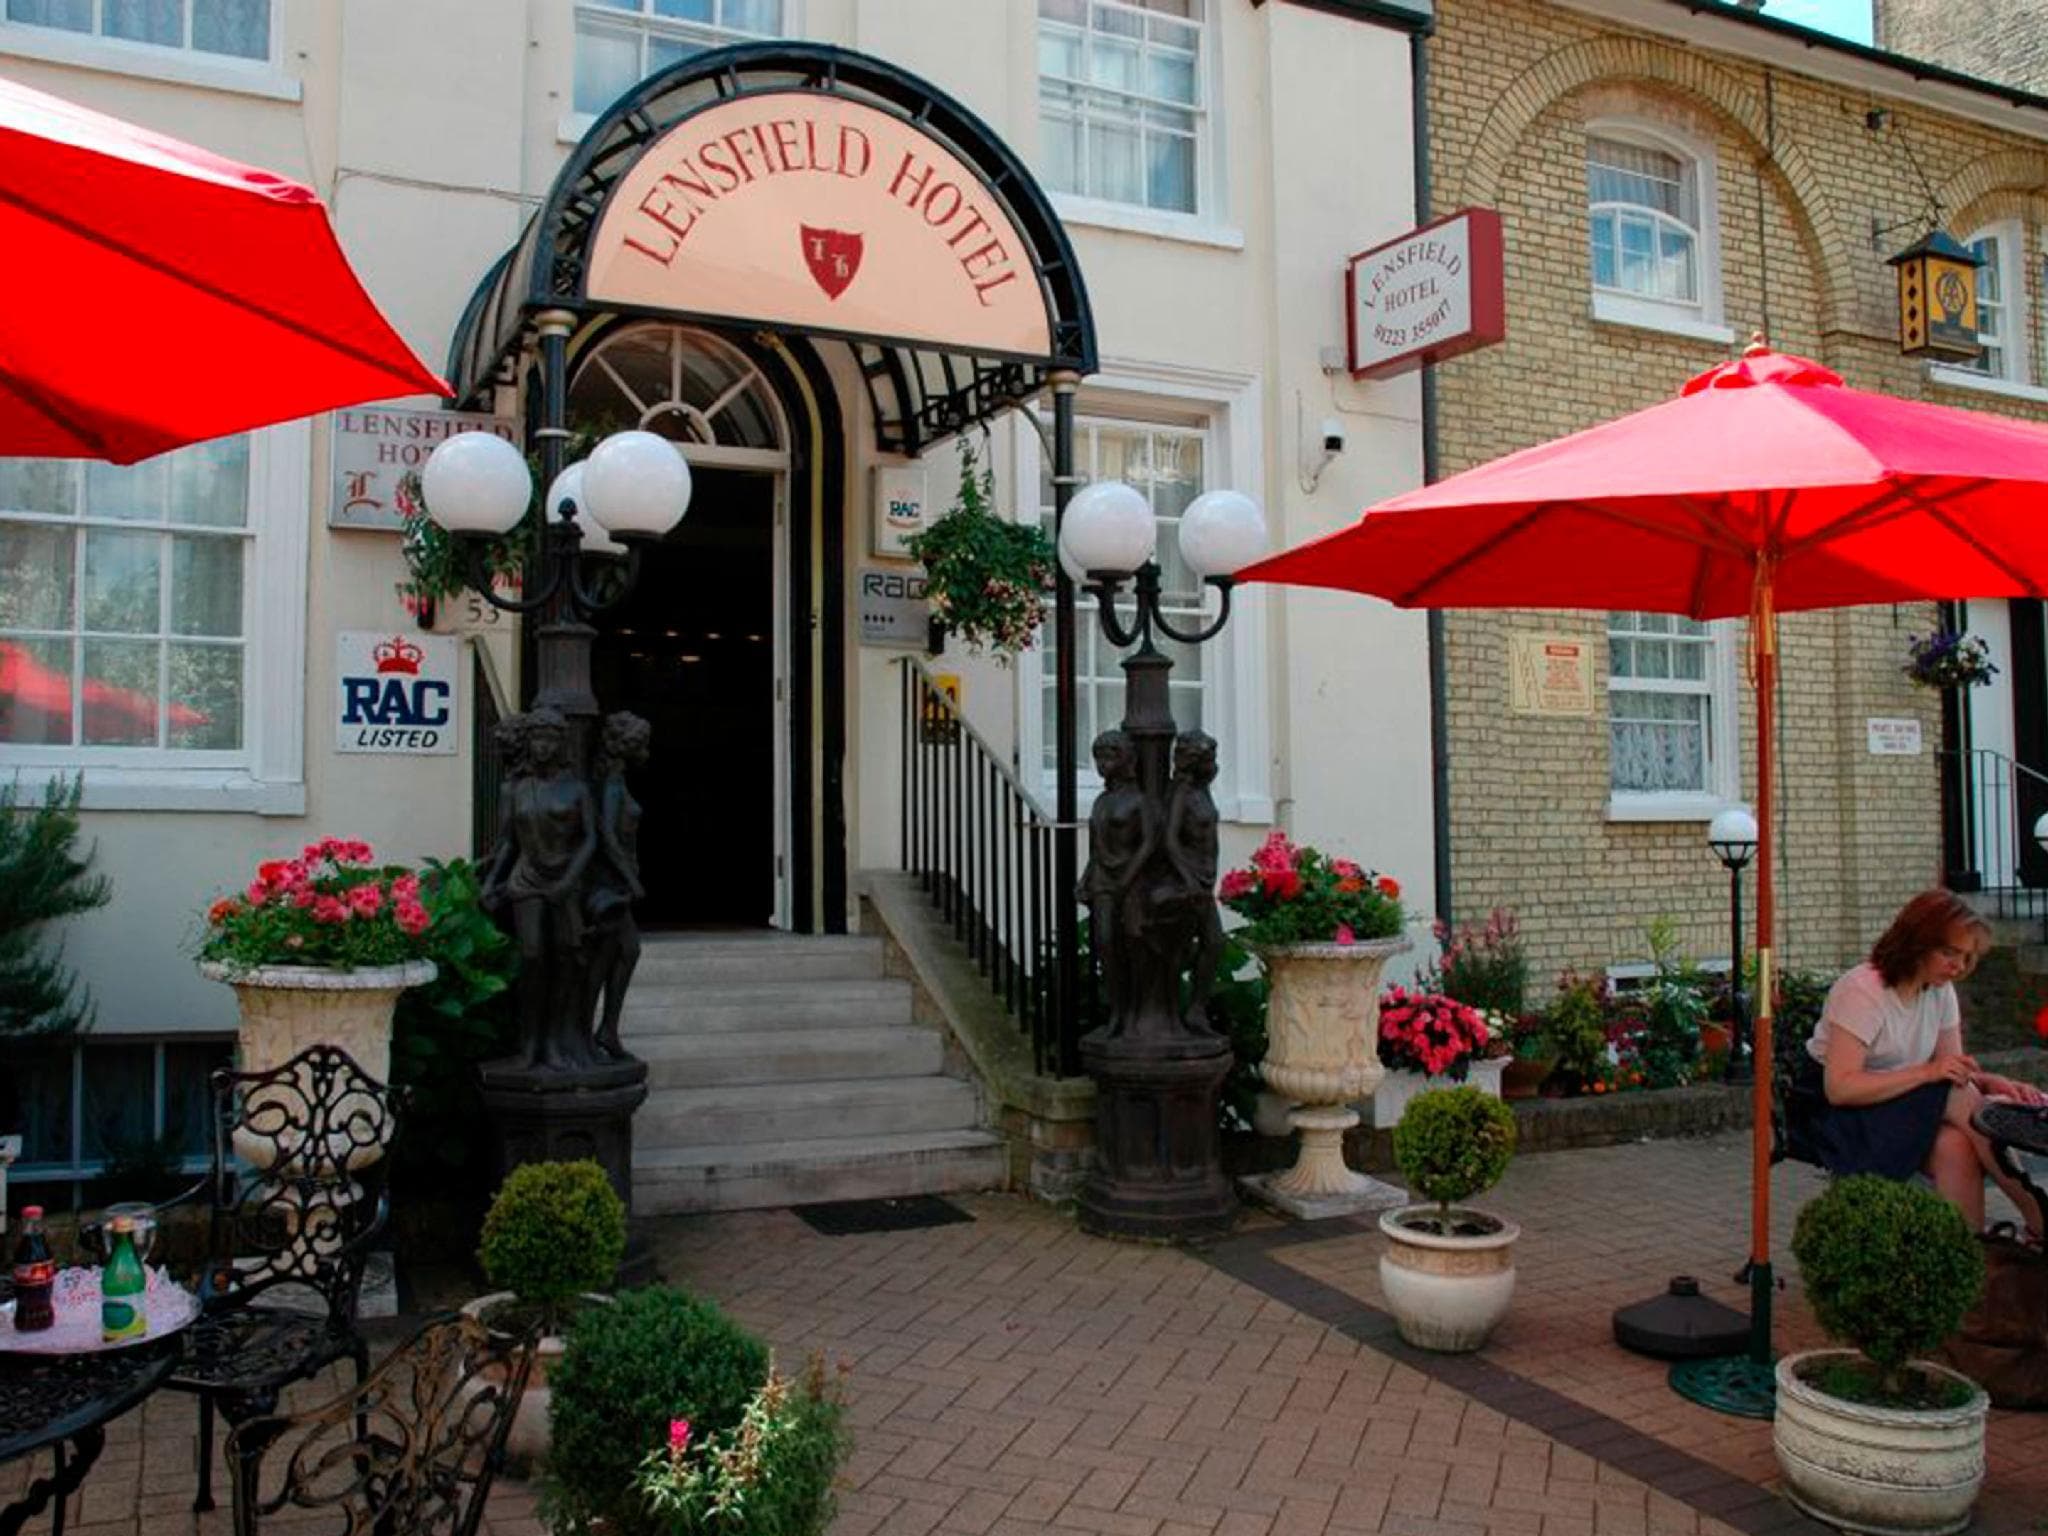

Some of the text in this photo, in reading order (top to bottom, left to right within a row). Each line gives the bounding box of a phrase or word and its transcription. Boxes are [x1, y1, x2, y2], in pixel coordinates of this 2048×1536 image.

[624, 119, 1019, 307] LENSFIELD HOTEL
[1364, 241, 1462, 309] LENSFIELD
[1384, 277, 1440, 312] HOTEL
[889, 500, 921, 518] RAC
[342, 677, 450, 726] RAC
[357, 729, 440, 749] LISTED
